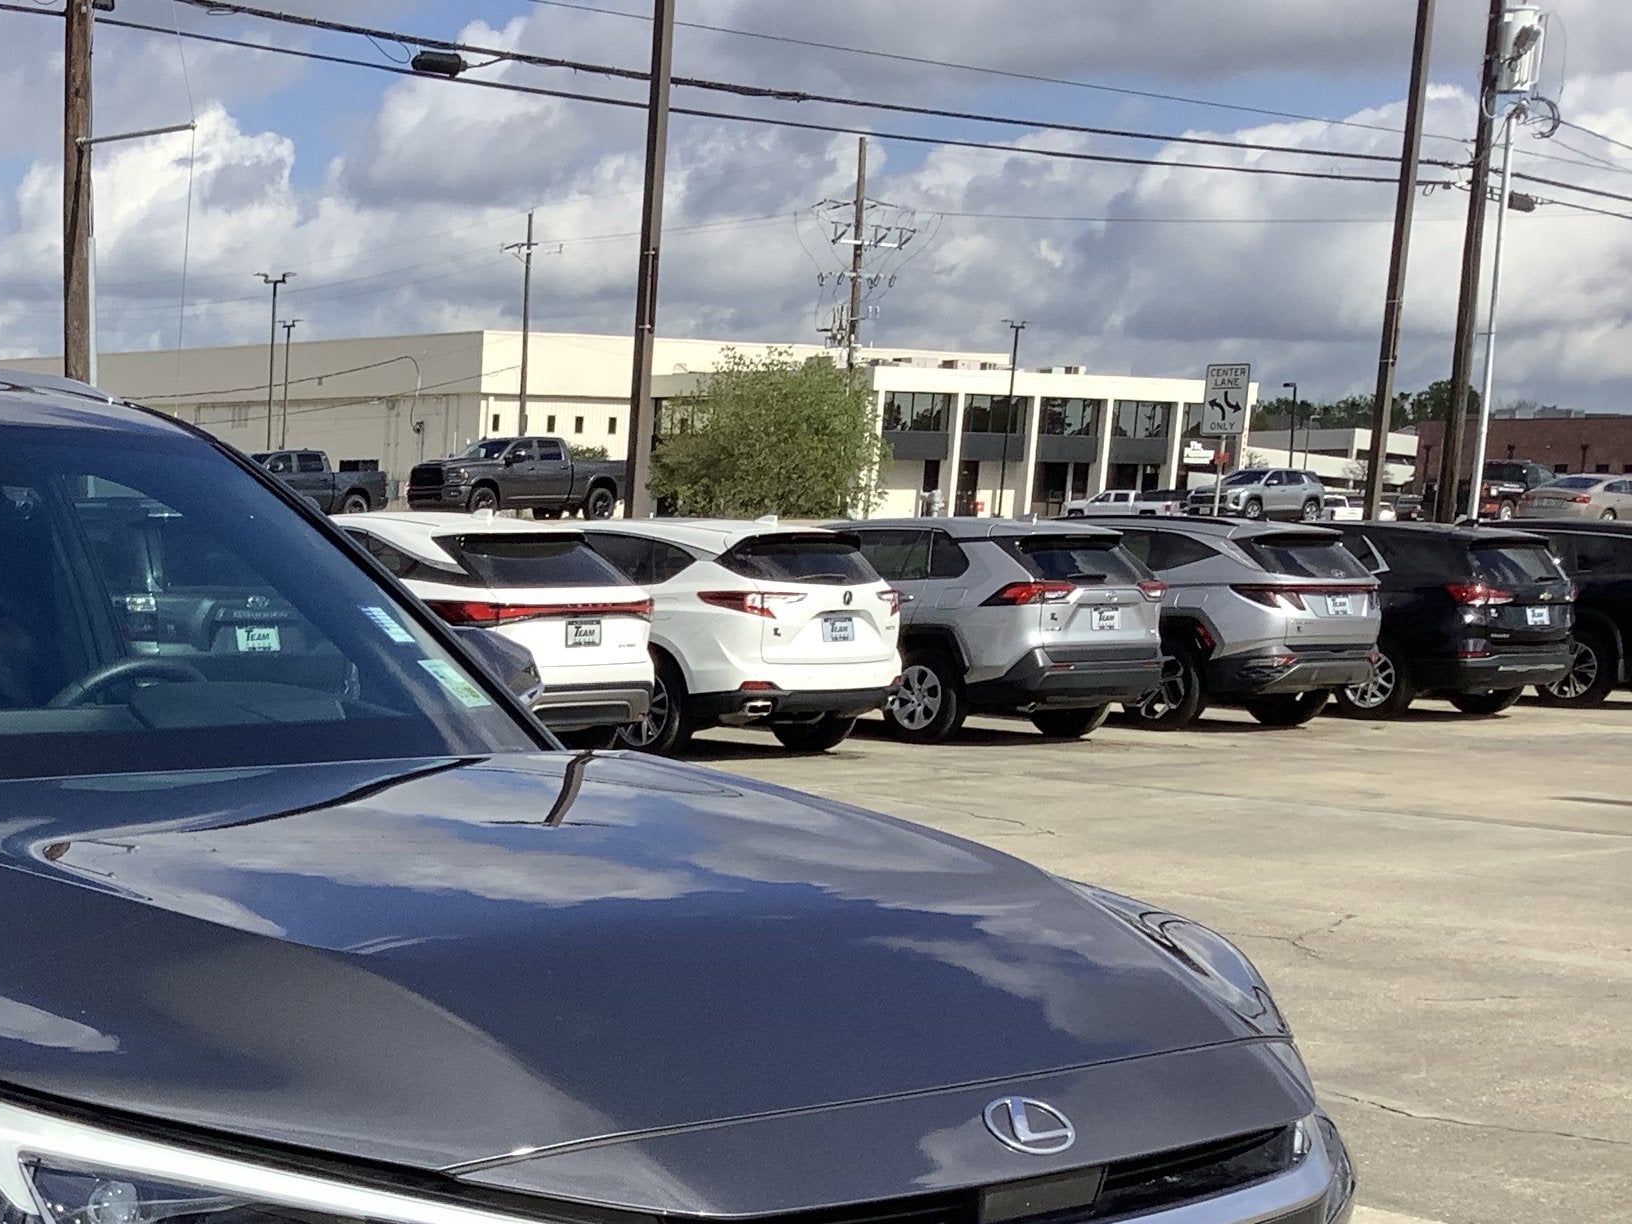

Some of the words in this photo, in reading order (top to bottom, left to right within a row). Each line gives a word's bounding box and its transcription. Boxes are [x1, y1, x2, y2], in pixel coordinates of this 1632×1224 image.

[1210, 368, 1246, 378] CENTER
[1214, 378, 1240, 387] LANE
[1209, 422, 1236, 431] ONLY
[245, 629, 270, 642] TEAM
[574, 626, 596, 637] TEAM
